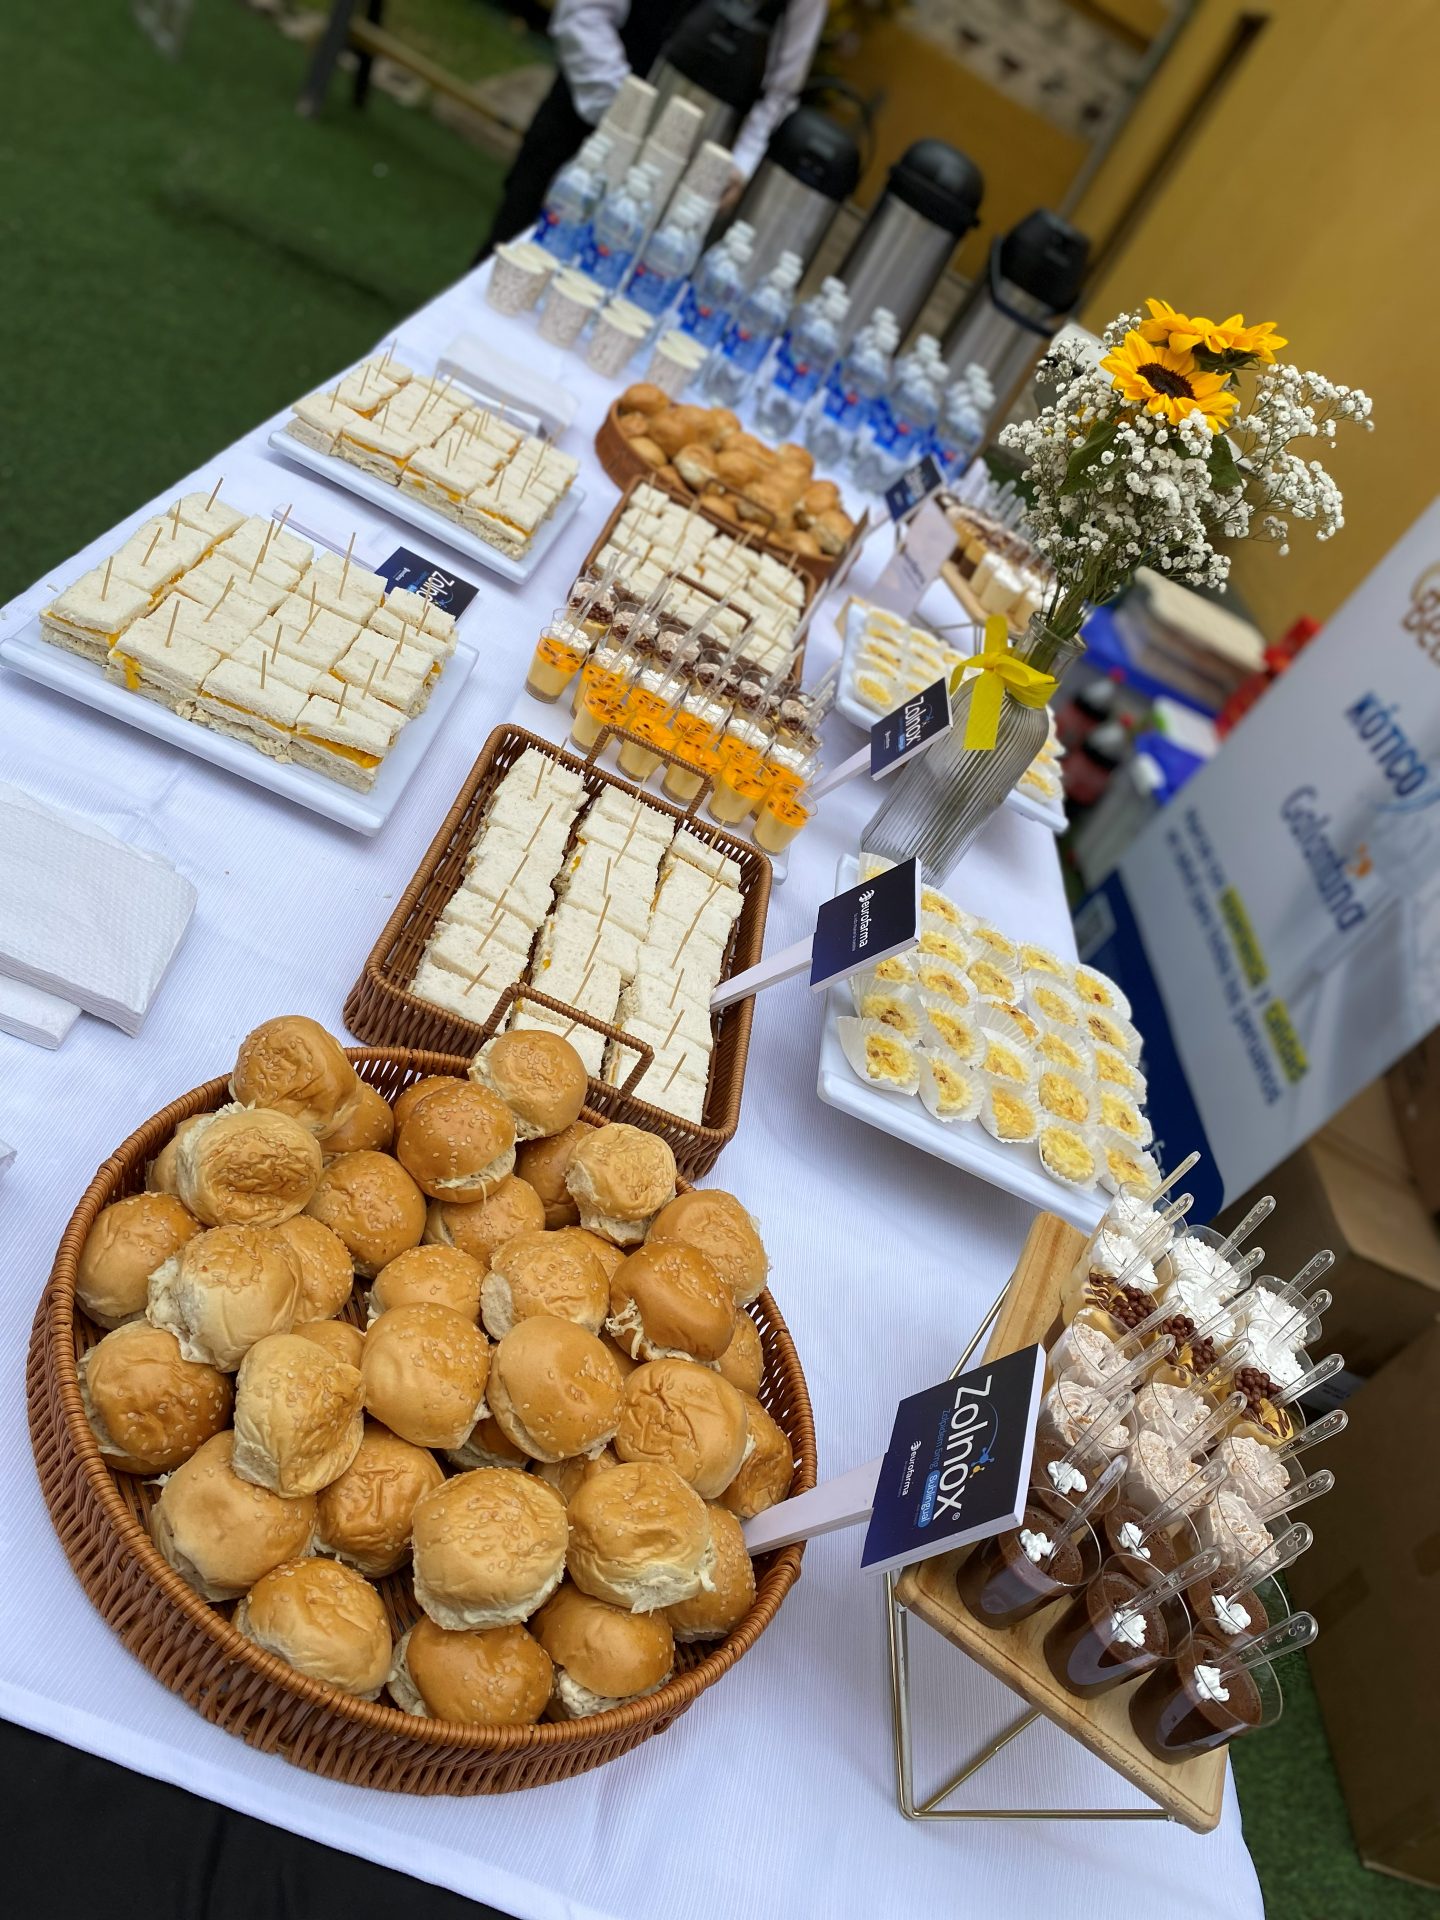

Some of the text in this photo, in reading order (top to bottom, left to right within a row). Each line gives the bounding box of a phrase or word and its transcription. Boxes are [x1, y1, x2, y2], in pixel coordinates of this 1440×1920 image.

[1345, 689, 1428, 797] KÓTICO
[1280, 784, 1367, 933] Galantina
[859, 900, 872, 948] eurofarma
[902, 1450, 917, 1496] eurofarma
[920, 1474, 938, 1523] Sublingual
